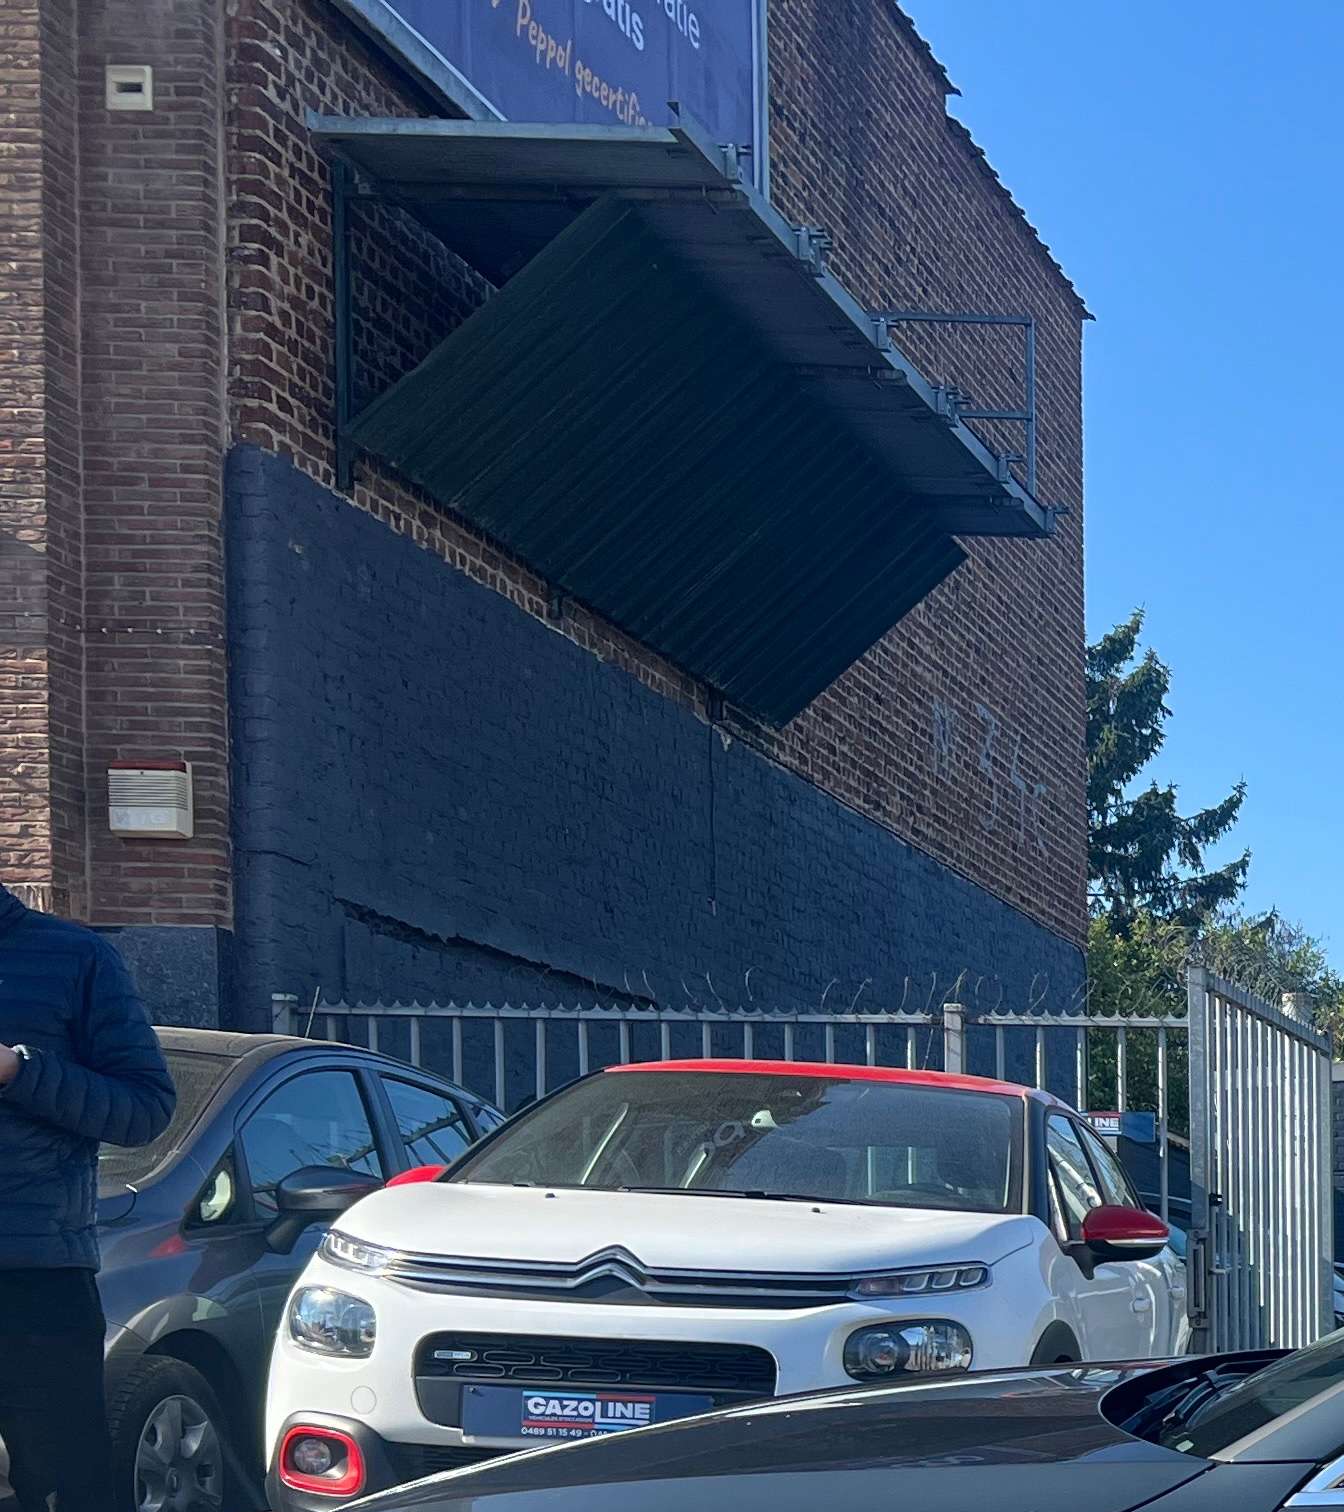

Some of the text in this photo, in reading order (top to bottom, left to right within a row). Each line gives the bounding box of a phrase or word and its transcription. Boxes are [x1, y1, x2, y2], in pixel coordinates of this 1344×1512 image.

[657, 0, 700, 49] atie
[515, 0, 653, 127] Peppol gecertifi
[527, 1397, 650, 1424] GAZOLINE
